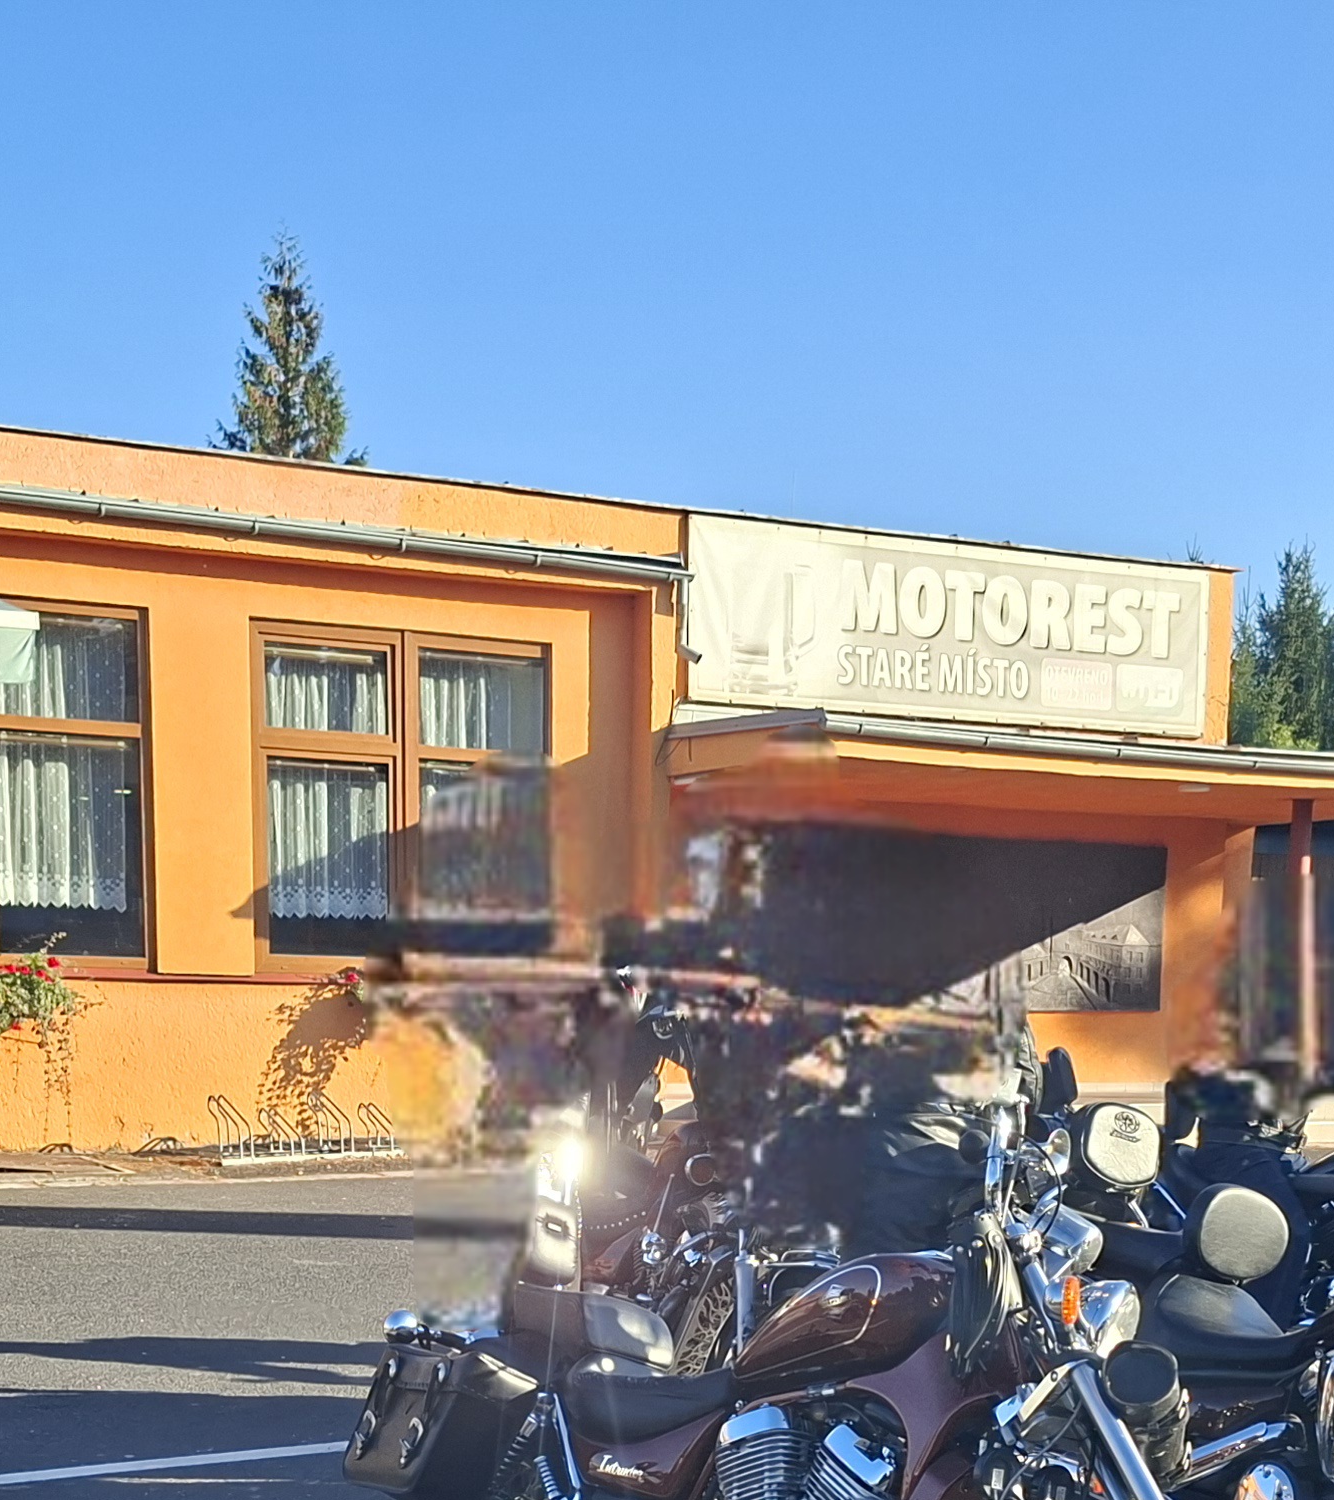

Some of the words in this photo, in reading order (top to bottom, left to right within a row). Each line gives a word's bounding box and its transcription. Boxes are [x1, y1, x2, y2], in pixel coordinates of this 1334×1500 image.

[841, 558, 1181, 659] MOTOREST
[837, 643, 931, 692] STARÉ
[938, 648, 1030, 699] MÍSTO
